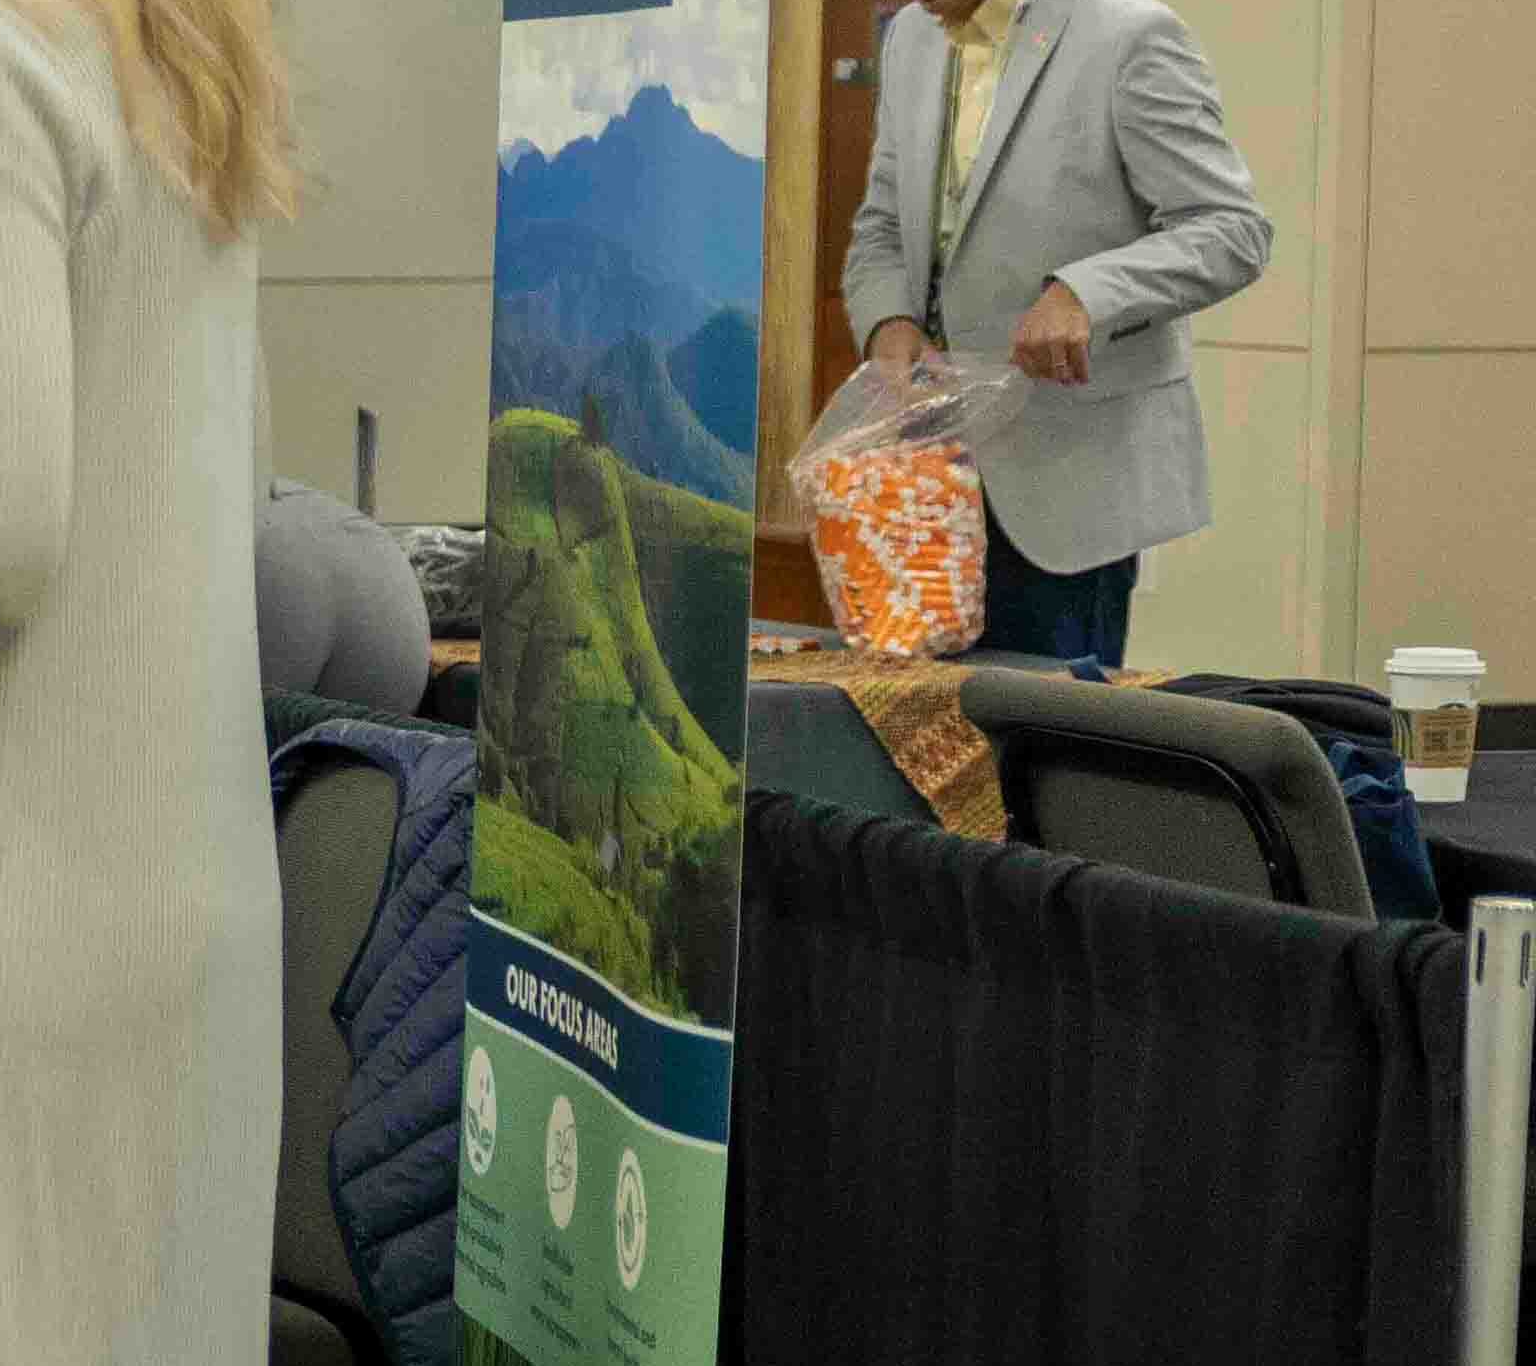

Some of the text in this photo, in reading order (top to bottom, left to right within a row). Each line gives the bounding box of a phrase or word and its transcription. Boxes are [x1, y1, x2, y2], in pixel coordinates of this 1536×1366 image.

[506, 964, 619, 1069] OUR FOCUS AREAS
